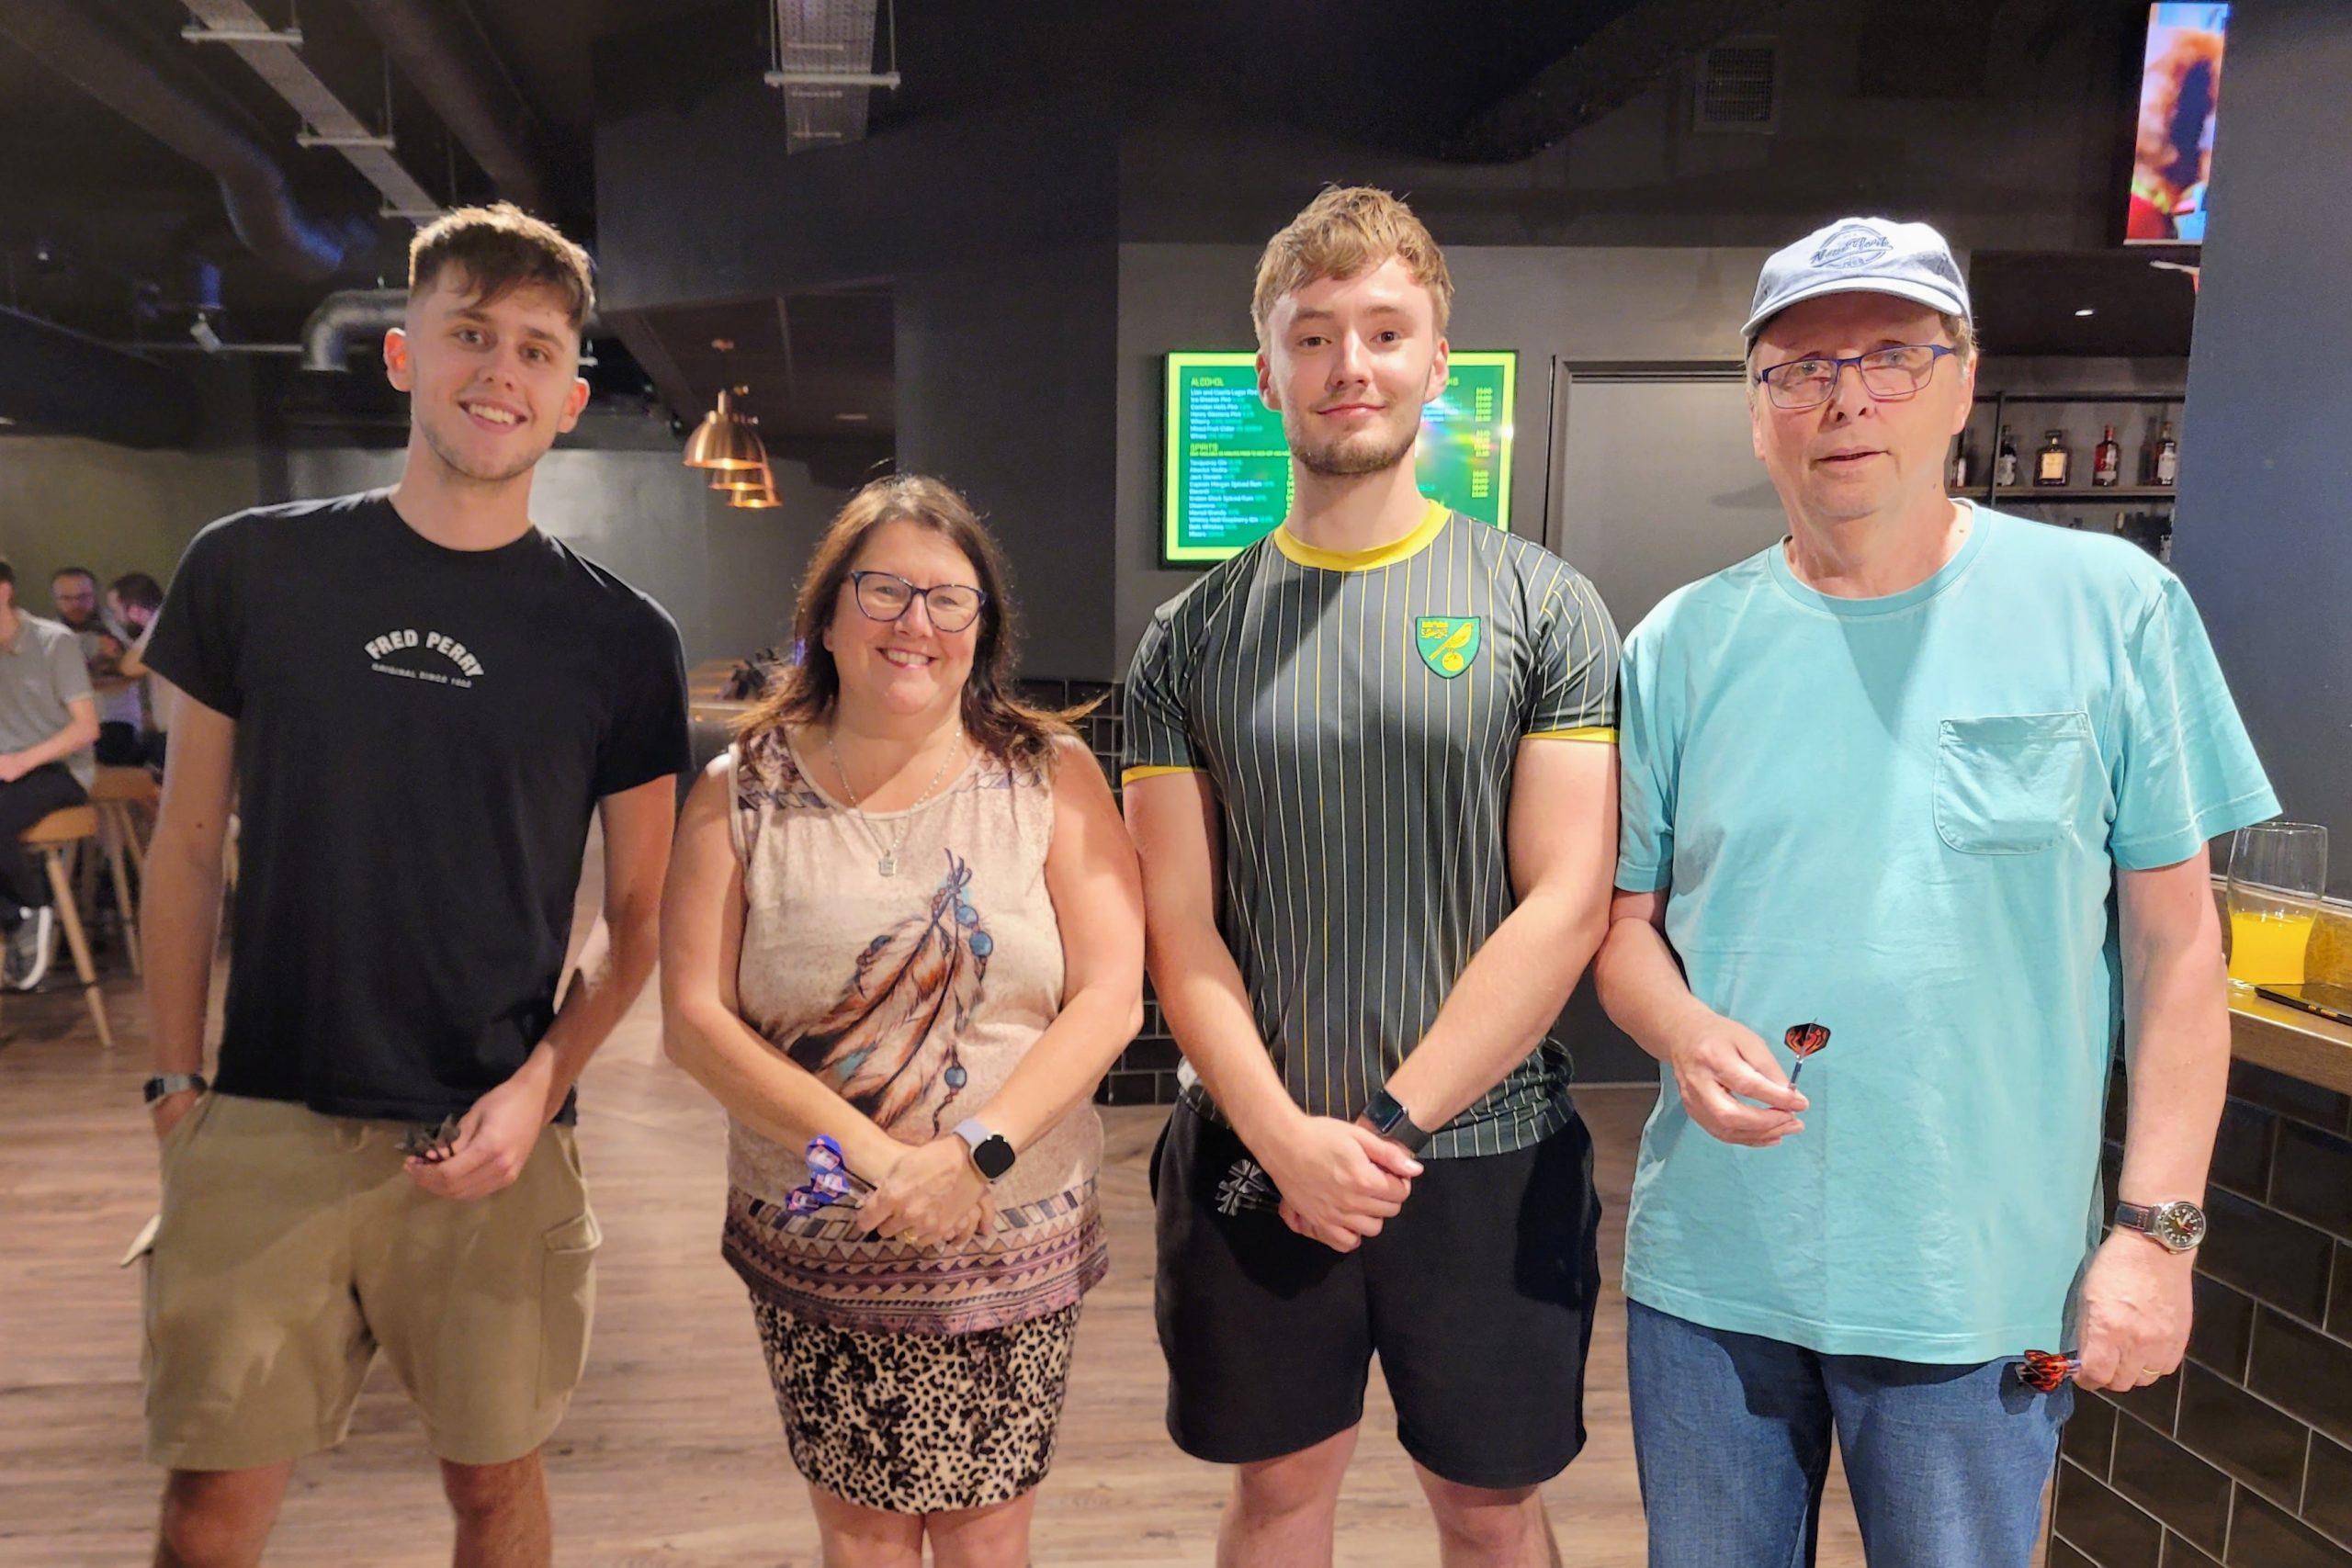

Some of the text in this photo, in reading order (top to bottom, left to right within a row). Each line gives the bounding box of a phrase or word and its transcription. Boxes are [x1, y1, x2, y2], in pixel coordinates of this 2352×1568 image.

[1191, 377, 1225, 387] ALCOHOL
[364, 628, 484, 677] FRED PERRY
